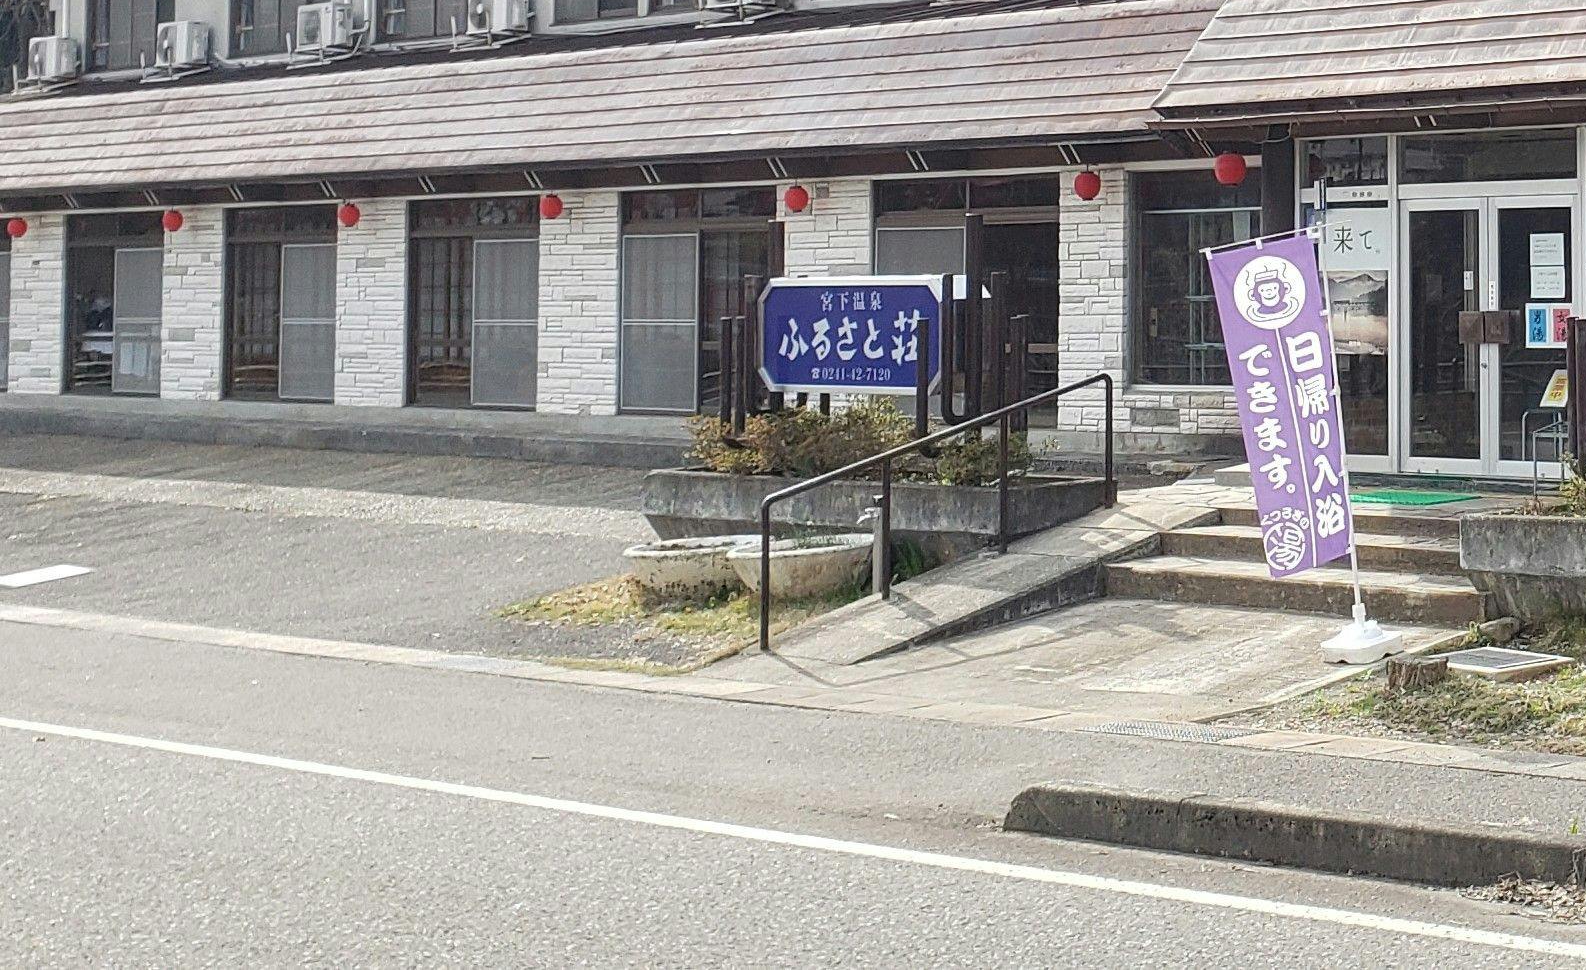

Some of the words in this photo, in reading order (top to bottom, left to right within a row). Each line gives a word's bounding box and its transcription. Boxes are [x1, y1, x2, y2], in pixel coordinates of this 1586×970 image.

[778, 309, 919, 365] ふるさと荘
[820, 290, 882, 311] 宮下温泉
[1238, 343, 1297, 495] できます。
[1285, 331, 1346, 539] 日帰り入浴
